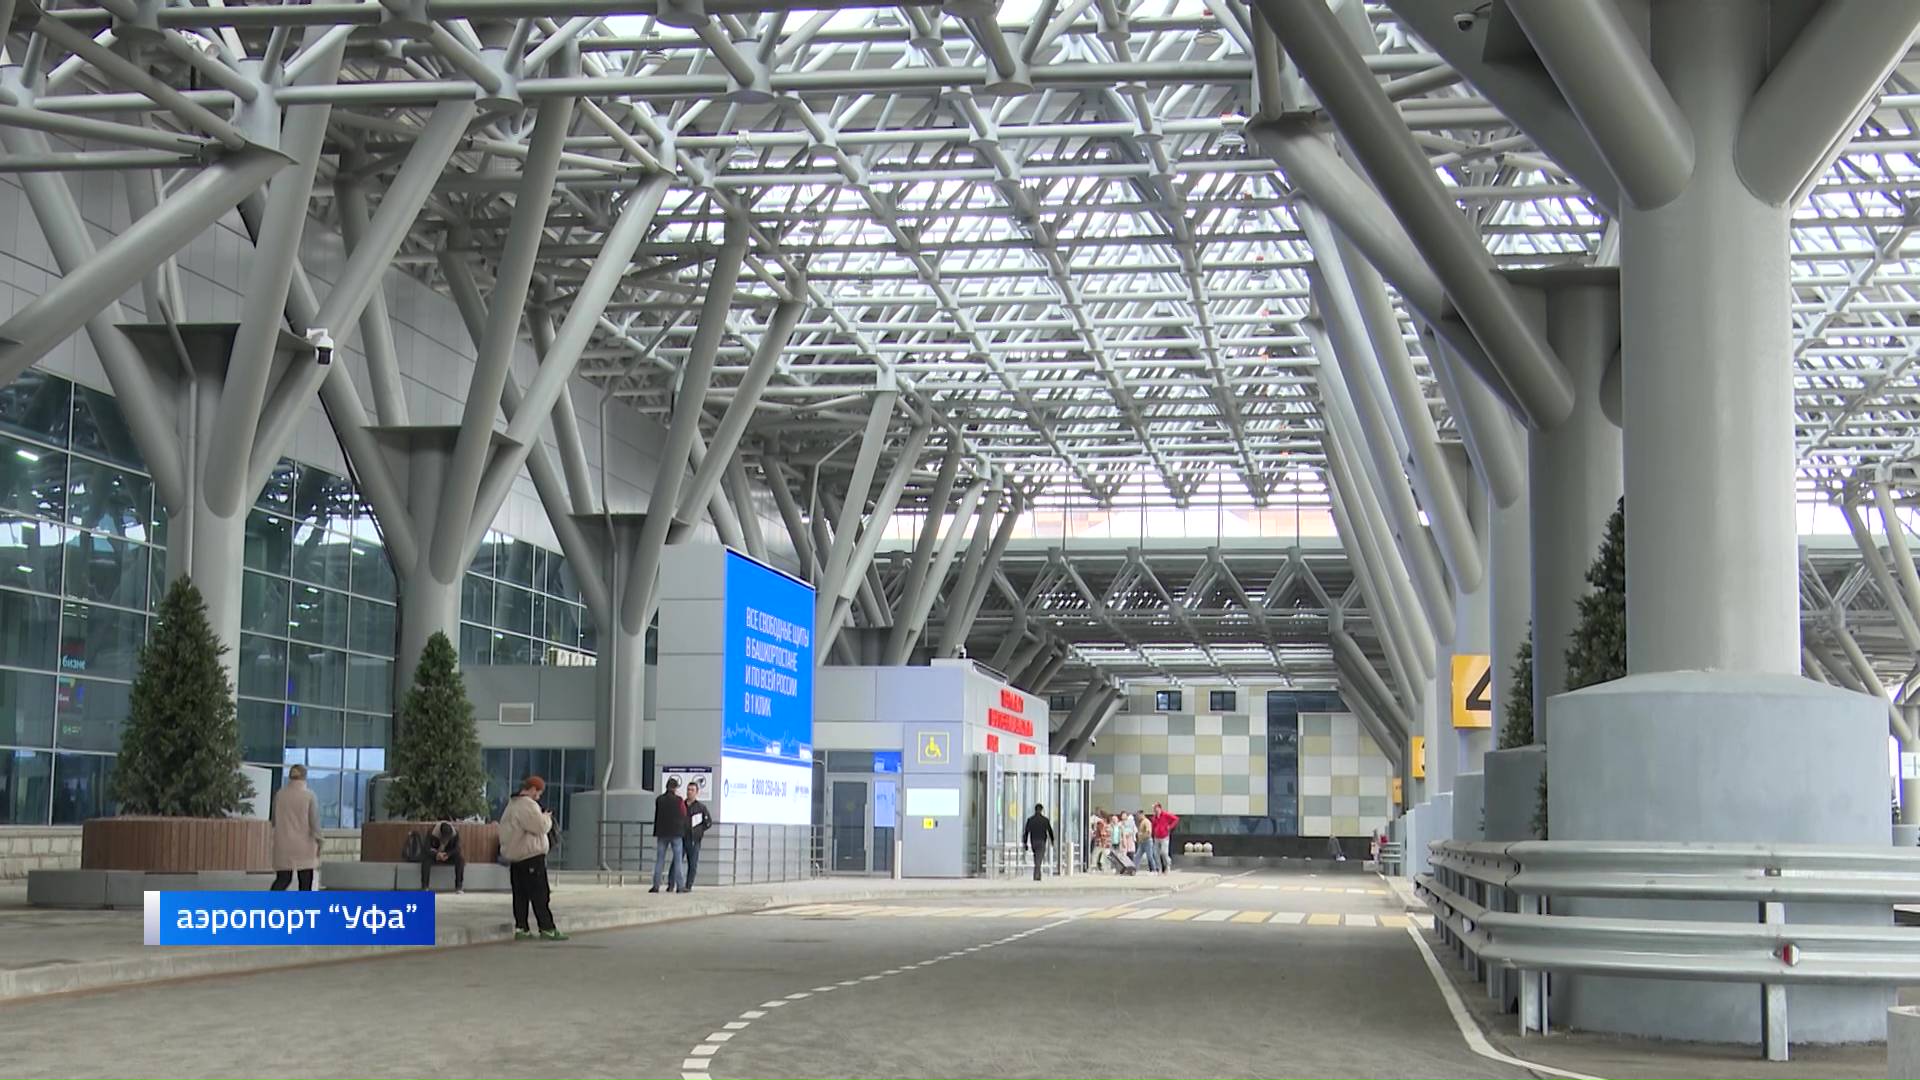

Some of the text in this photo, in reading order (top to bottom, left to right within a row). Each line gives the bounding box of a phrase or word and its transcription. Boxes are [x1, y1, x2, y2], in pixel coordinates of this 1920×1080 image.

[746, 606, 810, 648] ВСЕ СВОБОДНЫЕ ЩИТЫ
[746, 636, 798, 672] В БАШКОРТОСТАНЕ
[751, 666, 760, 688] ПО
[760, 668, 776, 692] ВСЕЙ
[776, 672, 798, 697] РОССИИ
[745, 692, 750, 713] В
[755, 695, 772, 717] КЛИК
[755, 778, 764, 795] 800
